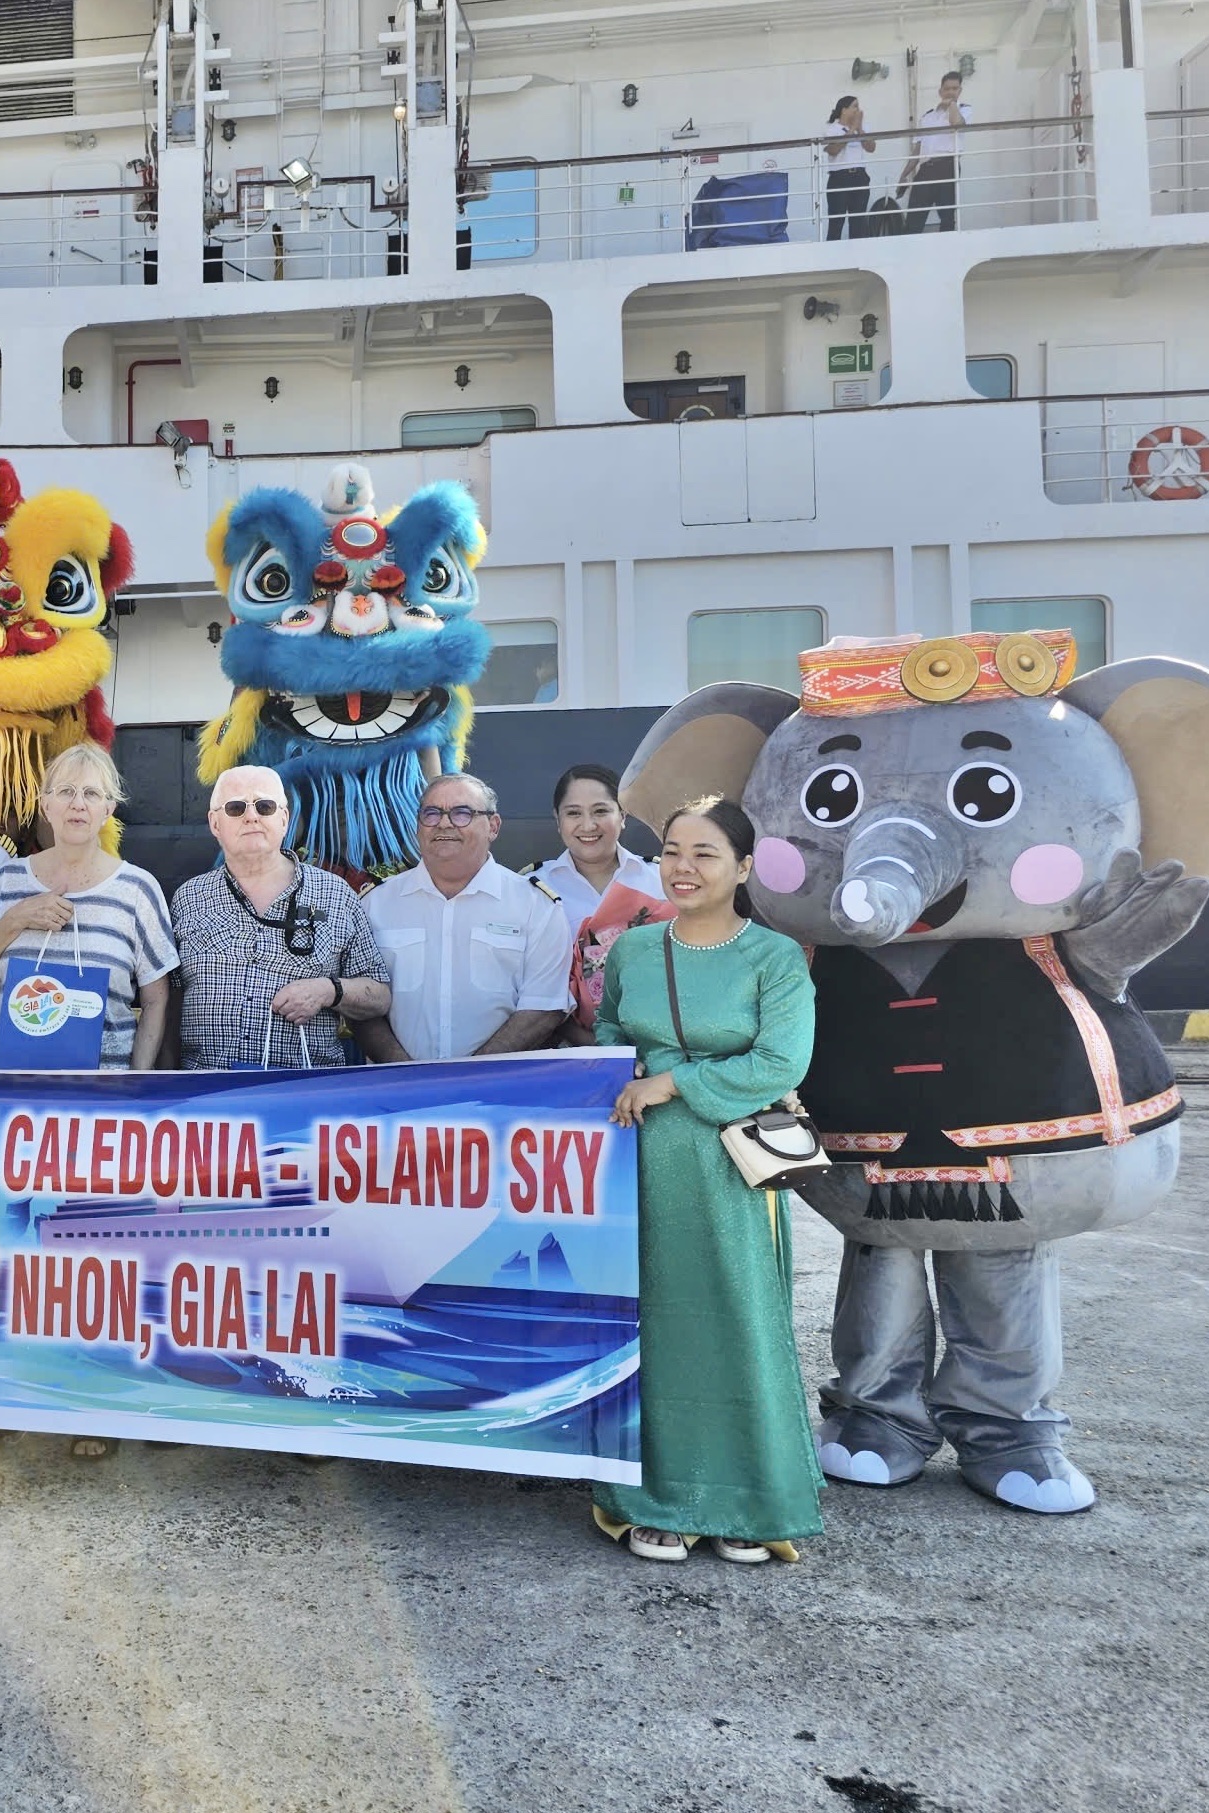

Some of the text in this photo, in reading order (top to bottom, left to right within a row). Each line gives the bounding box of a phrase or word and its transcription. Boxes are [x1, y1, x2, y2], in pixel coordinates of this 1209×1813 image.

[861, 350, 869, 366] 1
[22, 1000, 39, 1012] GIA
[3, 1114, 262, 1200] CALEDONIA
[279, 1164, 299, 1180] -
[317, 1123, 490, 1210] ISLAND
[509, 1127, 605, 1216] SKY
[11, 1253, 154, 1360] NHON,
[170, 1262, 248, 1350] GIA
[266, 1269, 337, 1358] LAI
